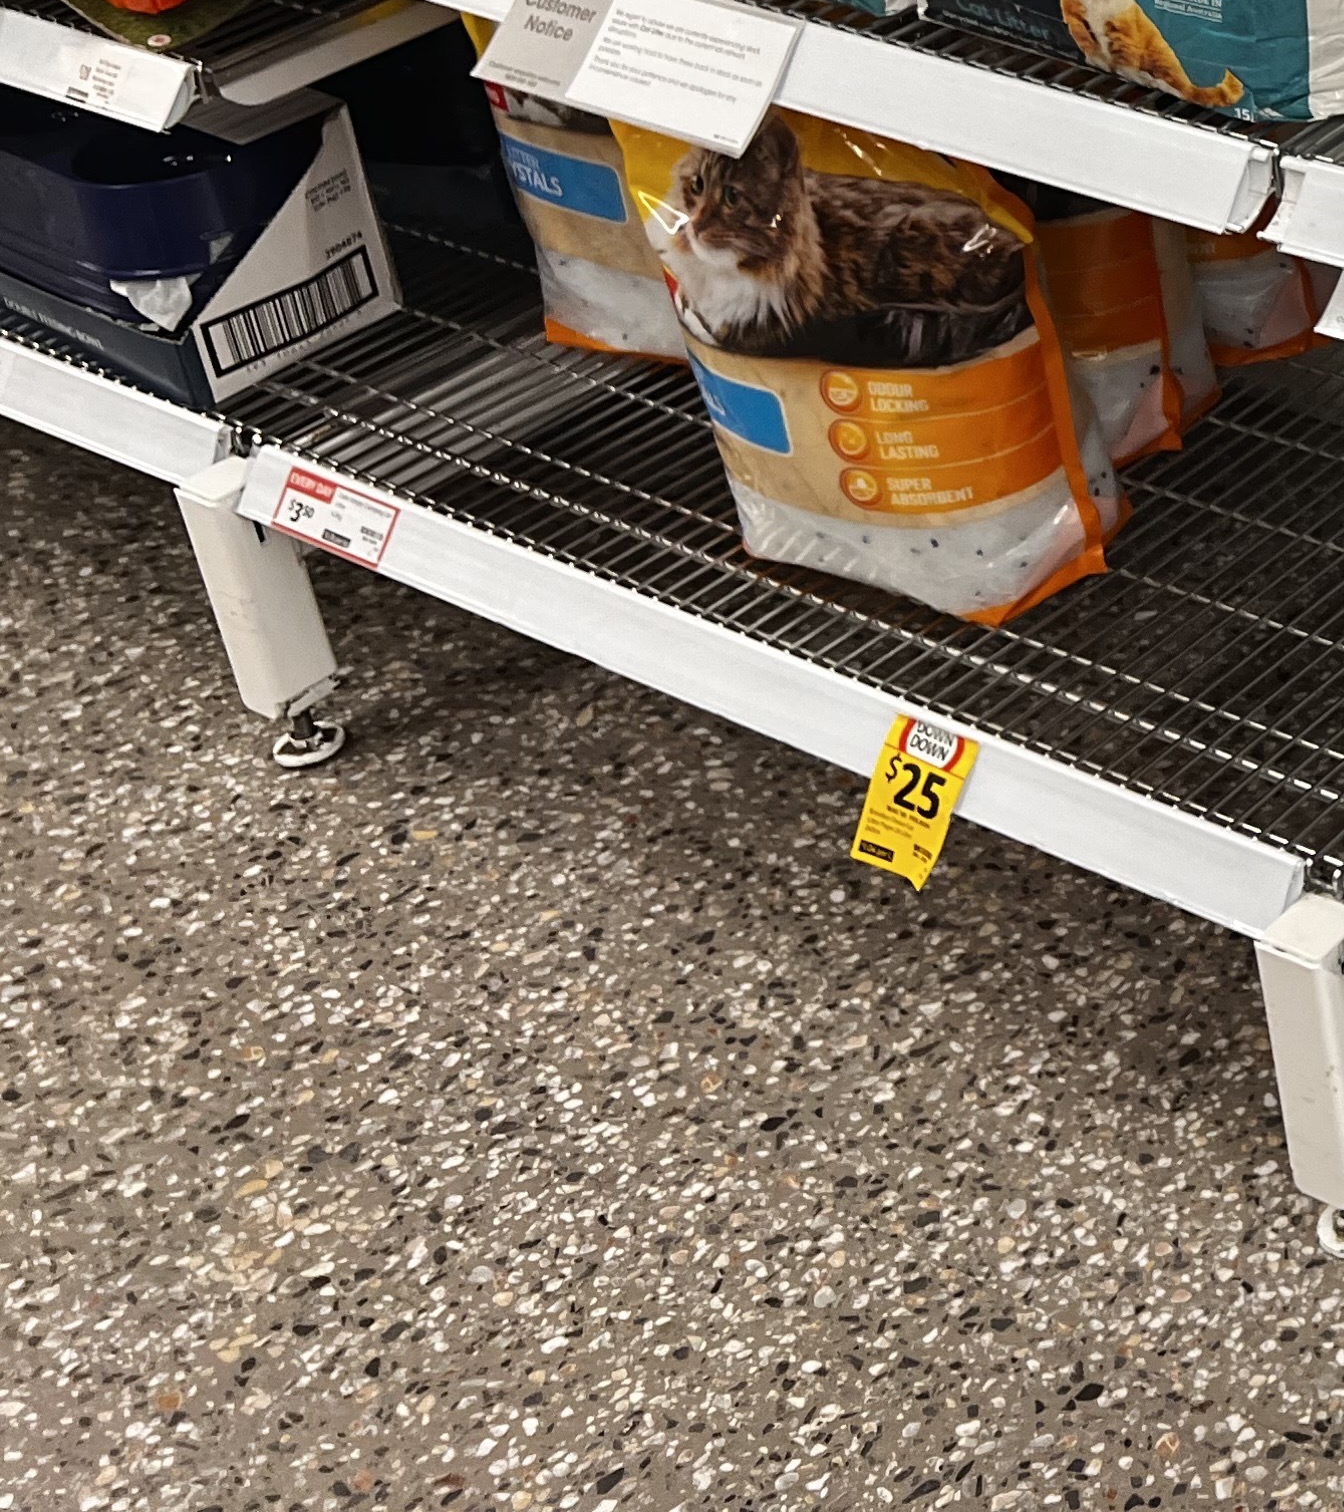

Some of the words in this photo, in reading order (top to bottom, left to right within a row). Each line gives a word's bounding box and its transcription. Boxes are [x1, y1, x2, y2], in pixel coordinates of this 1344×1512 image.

[524, 14, 573, 42] Notice
[876, 431, 913, 445] LONG
[880, 444, 940, 460] LASTING
[886, 477, 932, 491] SUPER
[909, 734, 949, 761] DOWN
[885, 752, 947, 820] $25
